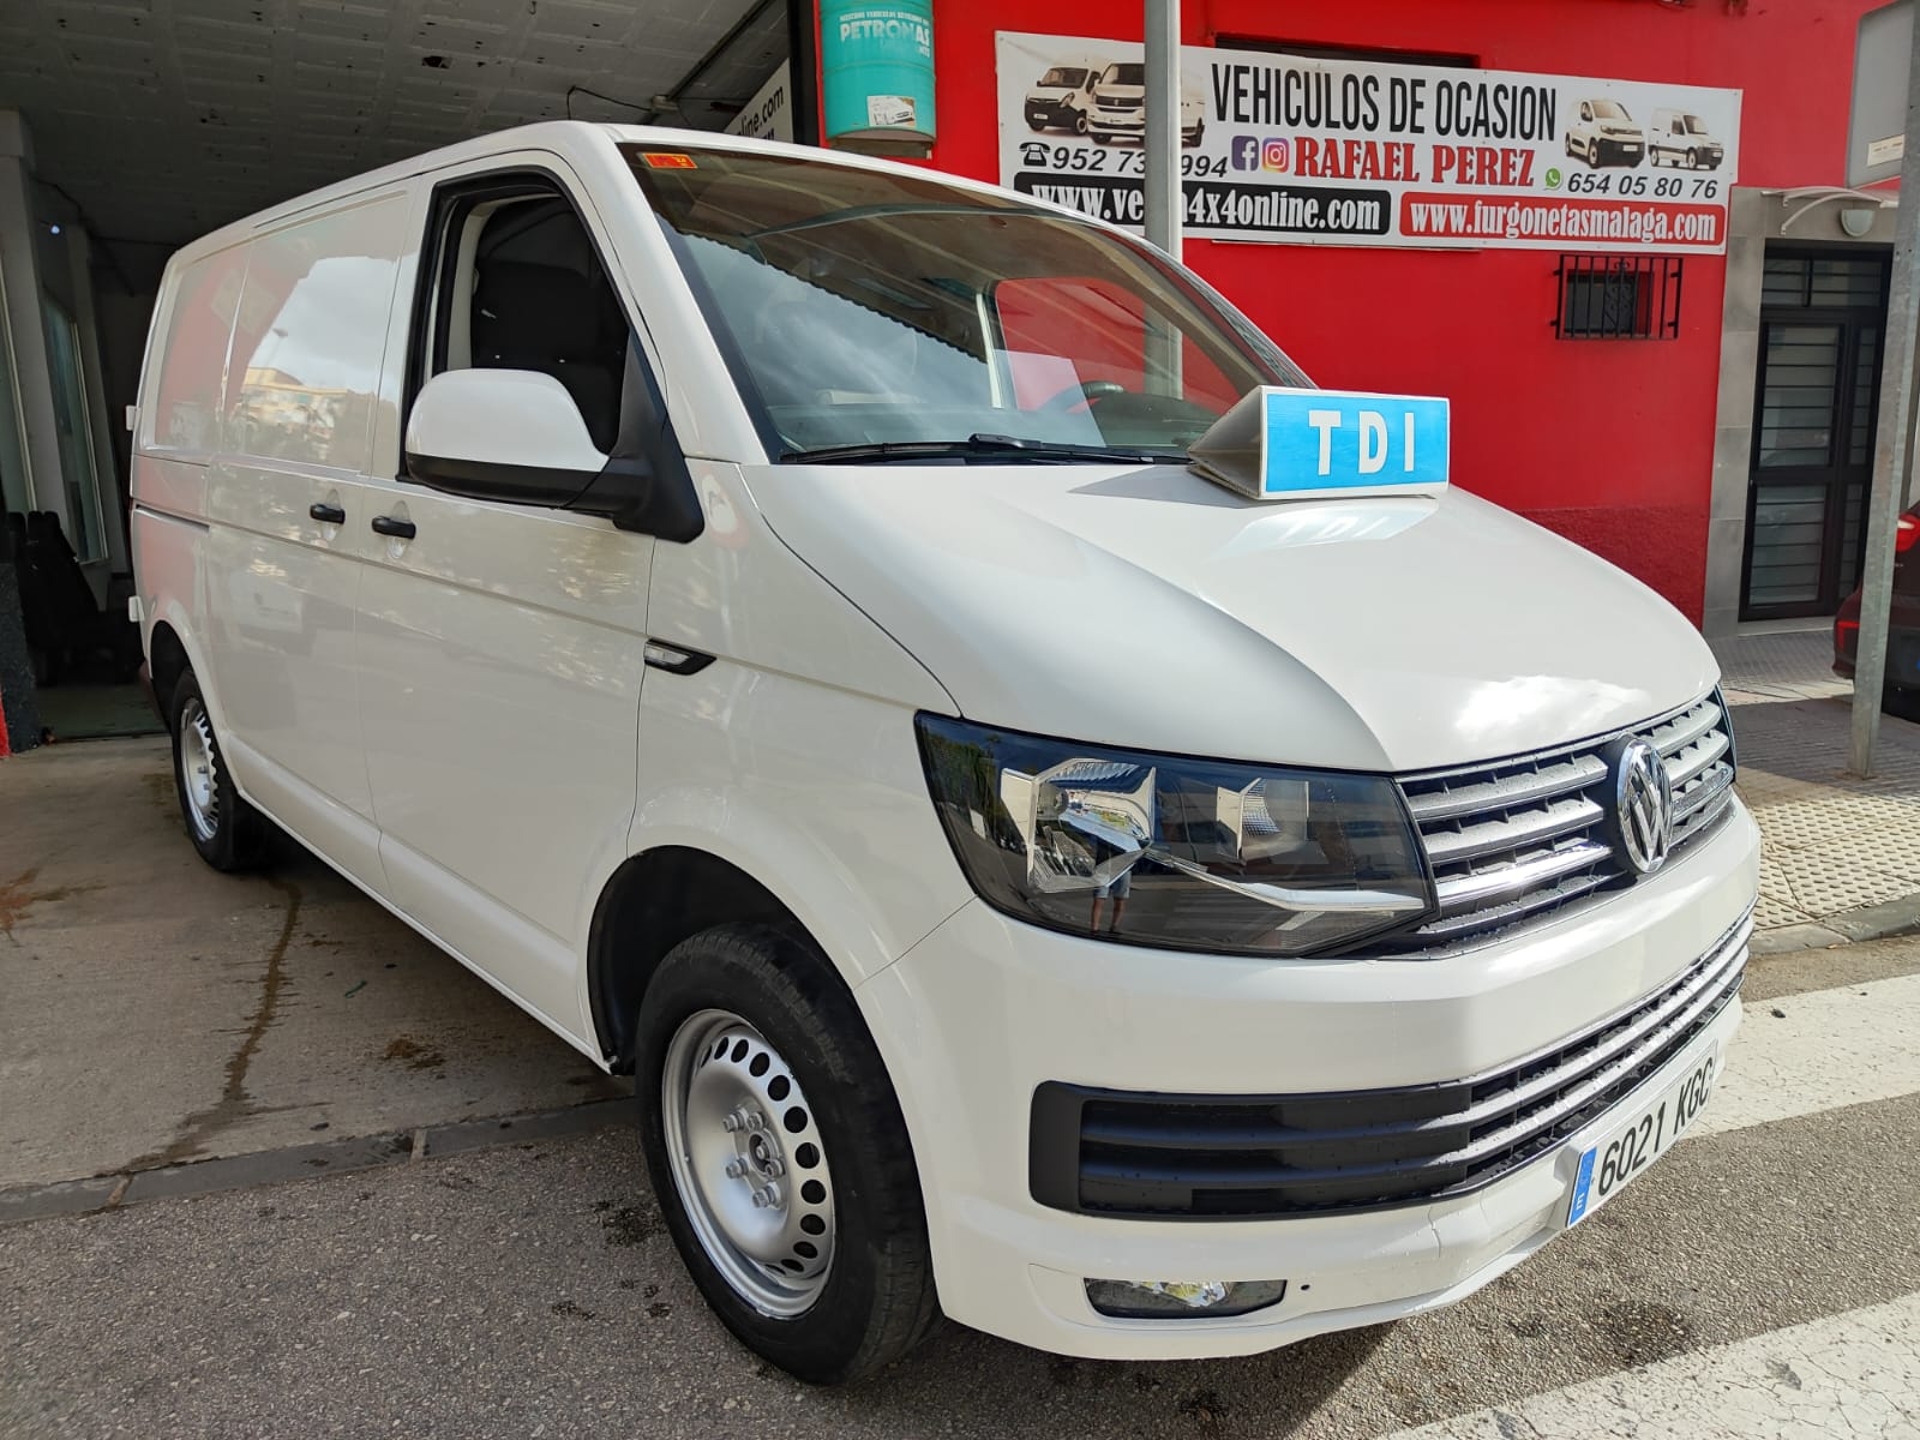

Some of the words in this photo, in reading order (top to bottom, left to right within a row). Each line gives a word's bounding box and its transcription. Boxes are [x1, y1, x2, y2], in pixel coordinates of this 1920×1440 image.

[840, 19, 930, 47] PETRONAS
[1211, 63, 1380, 132] VEHICULOS
[1389, 77, 1427, 135] DE
[1434, 80, 1557, 142] OCASION
[1052, 147, 1108, 172] 952
[1181, 154, 1229, 178] 994
[1293, 136, 1420, 183] RAFAEL
[1431, 144, 1535, 187] PEREZ
[1567, 173, 1611, 195] 654
[1618, 174, 1647, 197] 05
[1654, 176, 1683, 198] 80
[1692, 178, 1718, 199] 76
[1410, 200, 1717, 243] www.furgonetasmalaga.com
[1308, 409, 1415, 476] TDI
[1598, 1101, 1667, 1197] 6021
[1673, 1056, 1713, 1136] KGC
